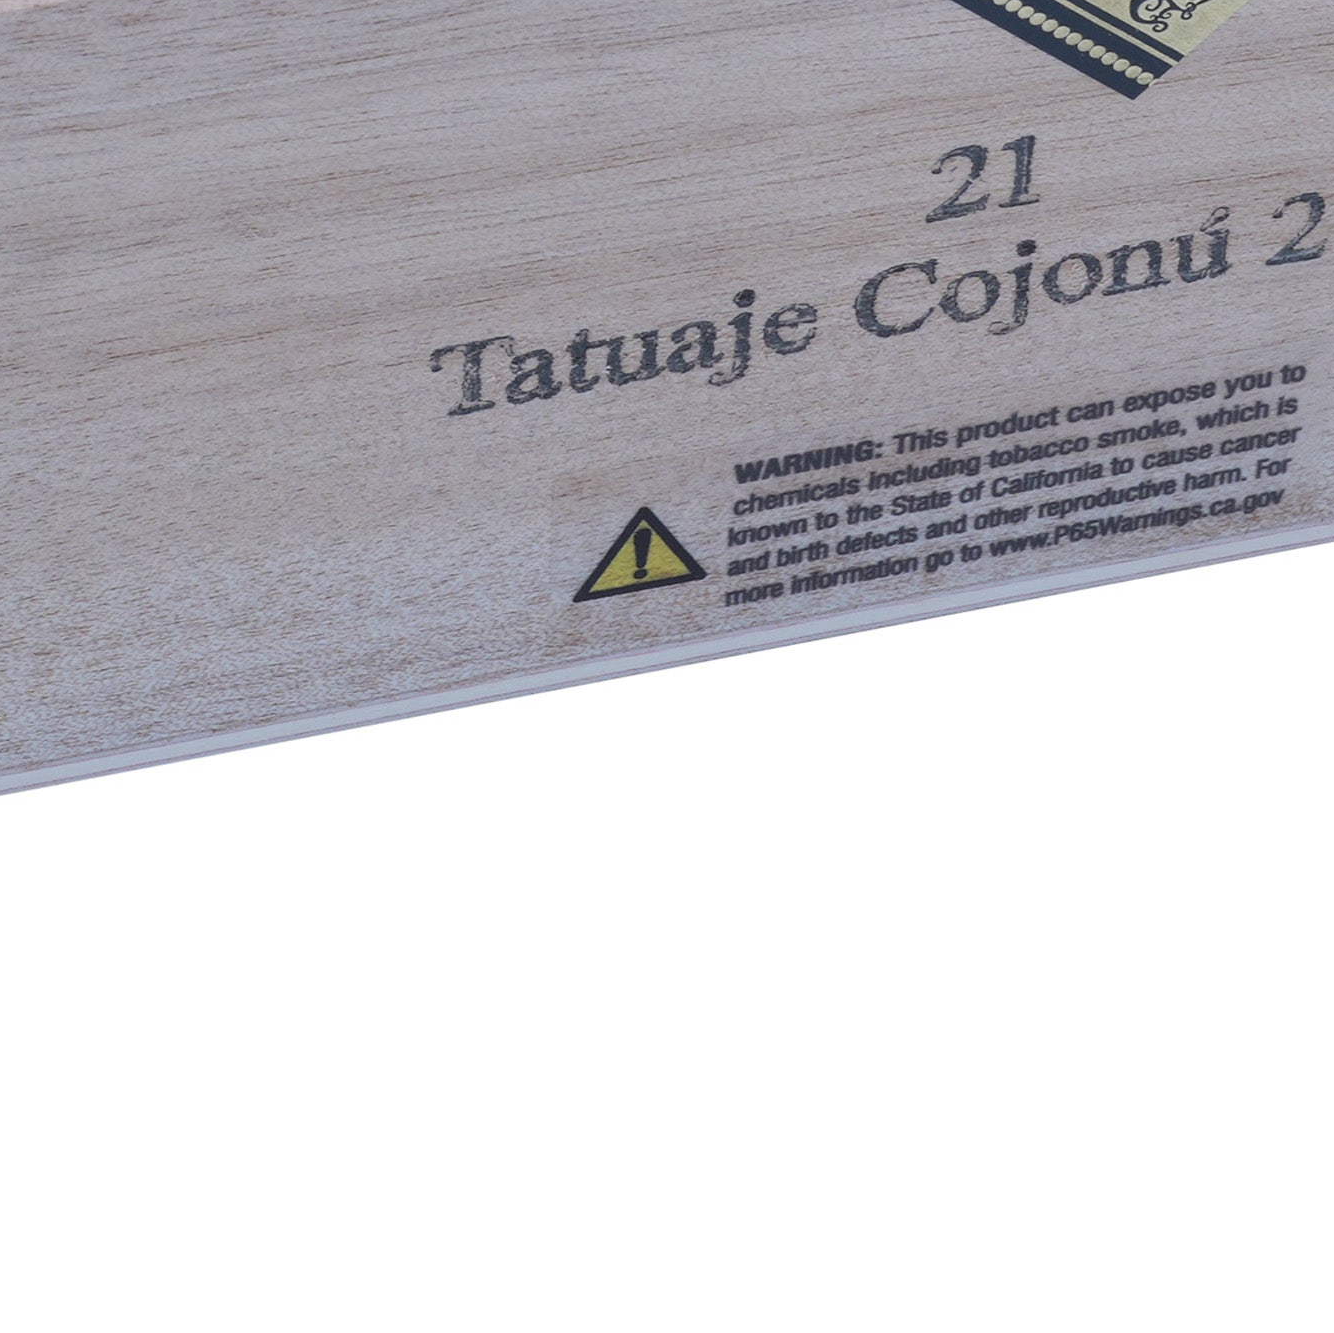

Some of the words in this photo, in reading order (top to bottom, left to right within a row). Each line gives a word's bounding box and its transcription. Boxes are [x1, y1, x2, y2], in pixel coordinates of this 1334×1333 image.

[925, 134, 1041, 223] 21
[430, 288, 819, 416] Tatuaje
[853, 206, 1232, 338] Cojonú
[733, 477, 860, 515] chemicals
[868, 455, 981, 491] including
[988, 436, 1089, 468] tobacco
[1097, 418, 1187, 449] smoke,
[1195, 401, 1269, 430] which
[1277, 396, 1299, 416] is
[734, 440, 883, 484] WARNING:
[893, 428, 948, 454] This
[956, 407, 1060, 448] product
[1067, 400, 1114, 423] can
[1123, 382, 1216, 412] expose
[1224, 371, 1272, 399] you
[1279, 364, 1307, 384] to
[727, 517, 808, 547] known
[814, 512, 838, 530] to
[846, 504, 884, 525] the
[891, 490, 952, 516] State
[958, 481, 985, 503] of
[991, 461, 1103, 498] California
[1110, 456, 1134, 476] to
[1142, 443, 1213, 471] cause
[1219, 427, 1302, 456] cancer
[727, 551, 769, 576] and
[776, 540, 829, 567] birth
[835, 525, 918, 556] defects
[925, 515, 967, 540] and
[974, 504, 1033, 530] other
[1038, 479, 1177, 518] reproductive
[1184, 466, 1247, 491] harm.
[1255, 457, 1292, 480] For
[725, 581, 784, 607] more
[790, 553, 918, 595] information
[924, 550, 954, 573] go
[960, 543, 983, 563] to
[989, 488, 1285, 557] www.P65Warnings.ca.gov
